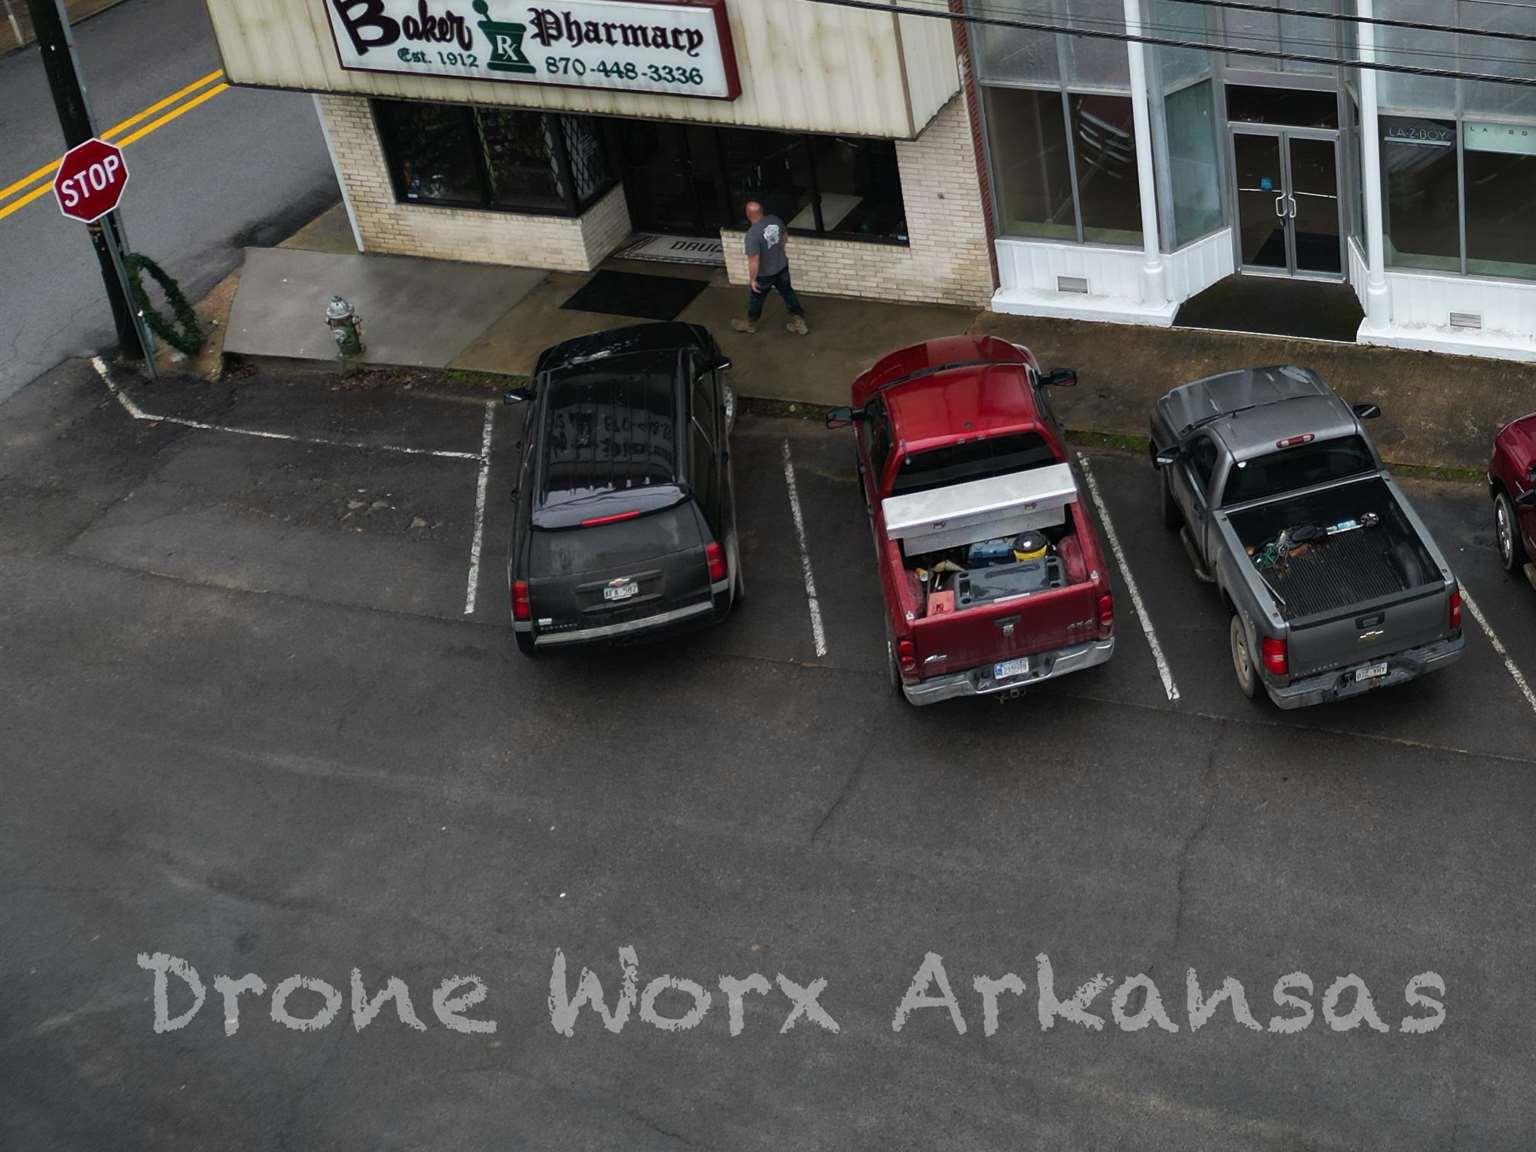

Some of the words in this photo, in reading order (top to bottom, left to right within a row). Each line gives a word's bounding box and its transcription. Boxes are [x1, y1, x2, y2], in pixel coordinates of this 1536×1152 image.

[527, 6, 704, 56] Pharmacy
[397, 47, 433, 65] Est.
[440, 51, 480, 69] 1912
[545, 56, 704, 86] 870-448-3336
[60, 154, 119, 207] STOP
